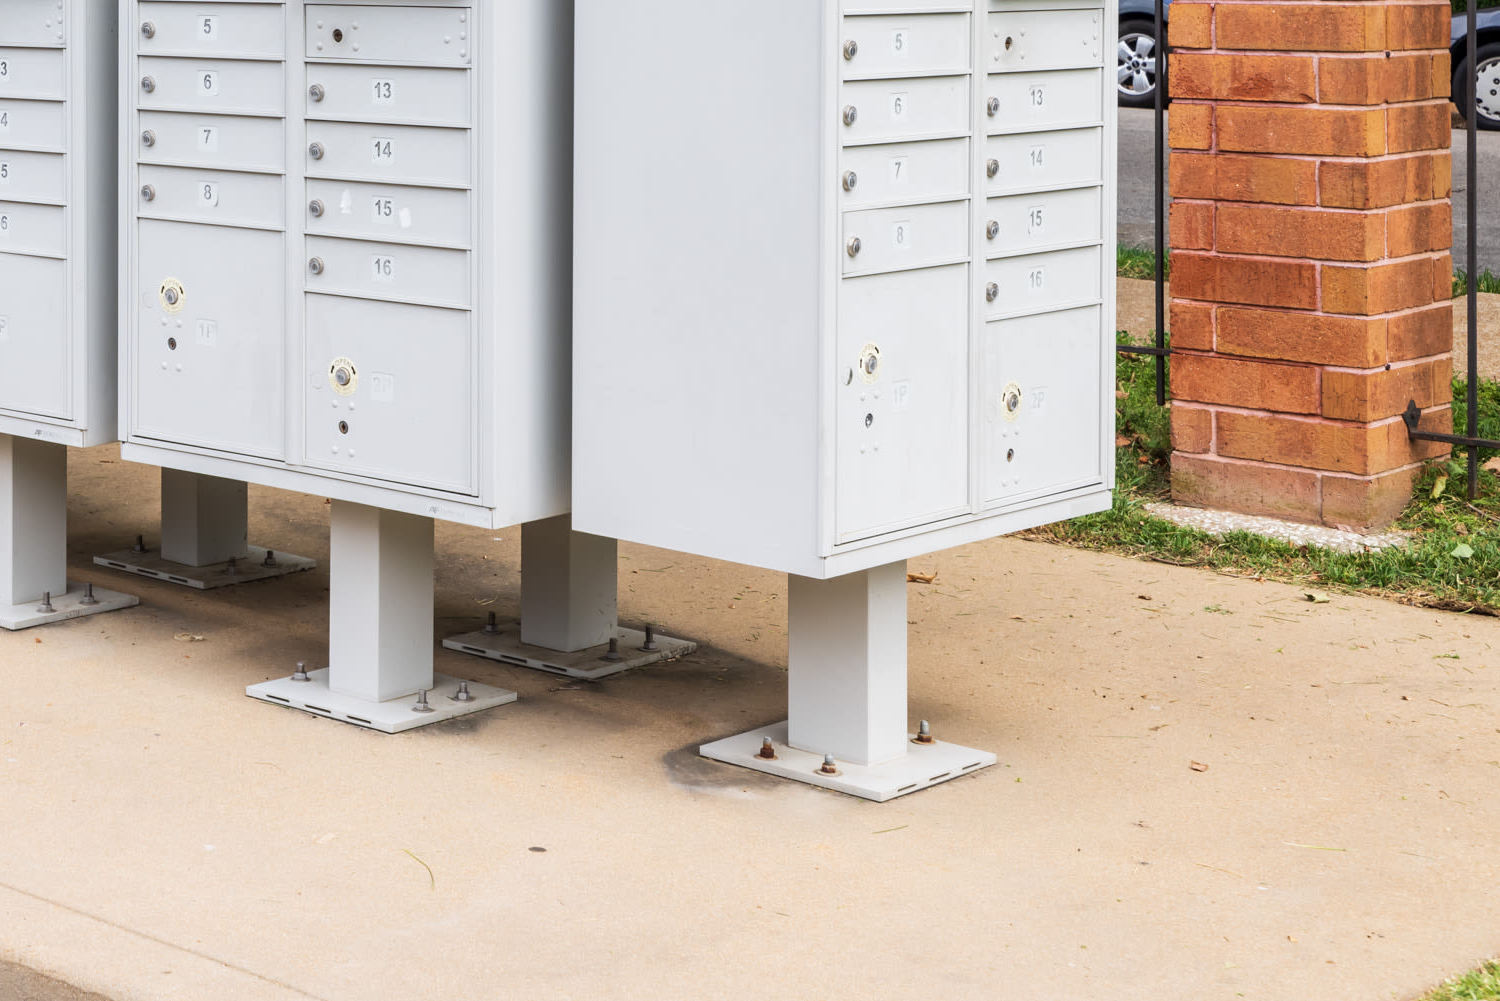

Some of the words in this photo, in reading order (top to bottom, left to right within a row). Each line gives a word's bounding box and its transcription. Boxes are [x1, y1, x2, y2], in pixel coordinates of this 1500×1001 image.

[203, 18, 212, 34] 5
[894, 32, 903, 51] 5
[203, 73, 212, 90] 6
[374, 81, 392, 99] 13
[894, 96, 902, 115] 6
[1030, 88, 1044, 106] 13
[203, 128, 212, 145] 7
[374, 140, 392, 158] 14
[1030, 148, 1043, 167] 14
[894, 160, 902, 179] 7
[203, 184, 212, 201] 8
[374, 199, 392, 217] 15
[1029, 209, 1043, 227] 15
[896, 225, 904, 244] 8
[374, 257, 392, 276] 16
[1029, 270, 1042, 288] 16
